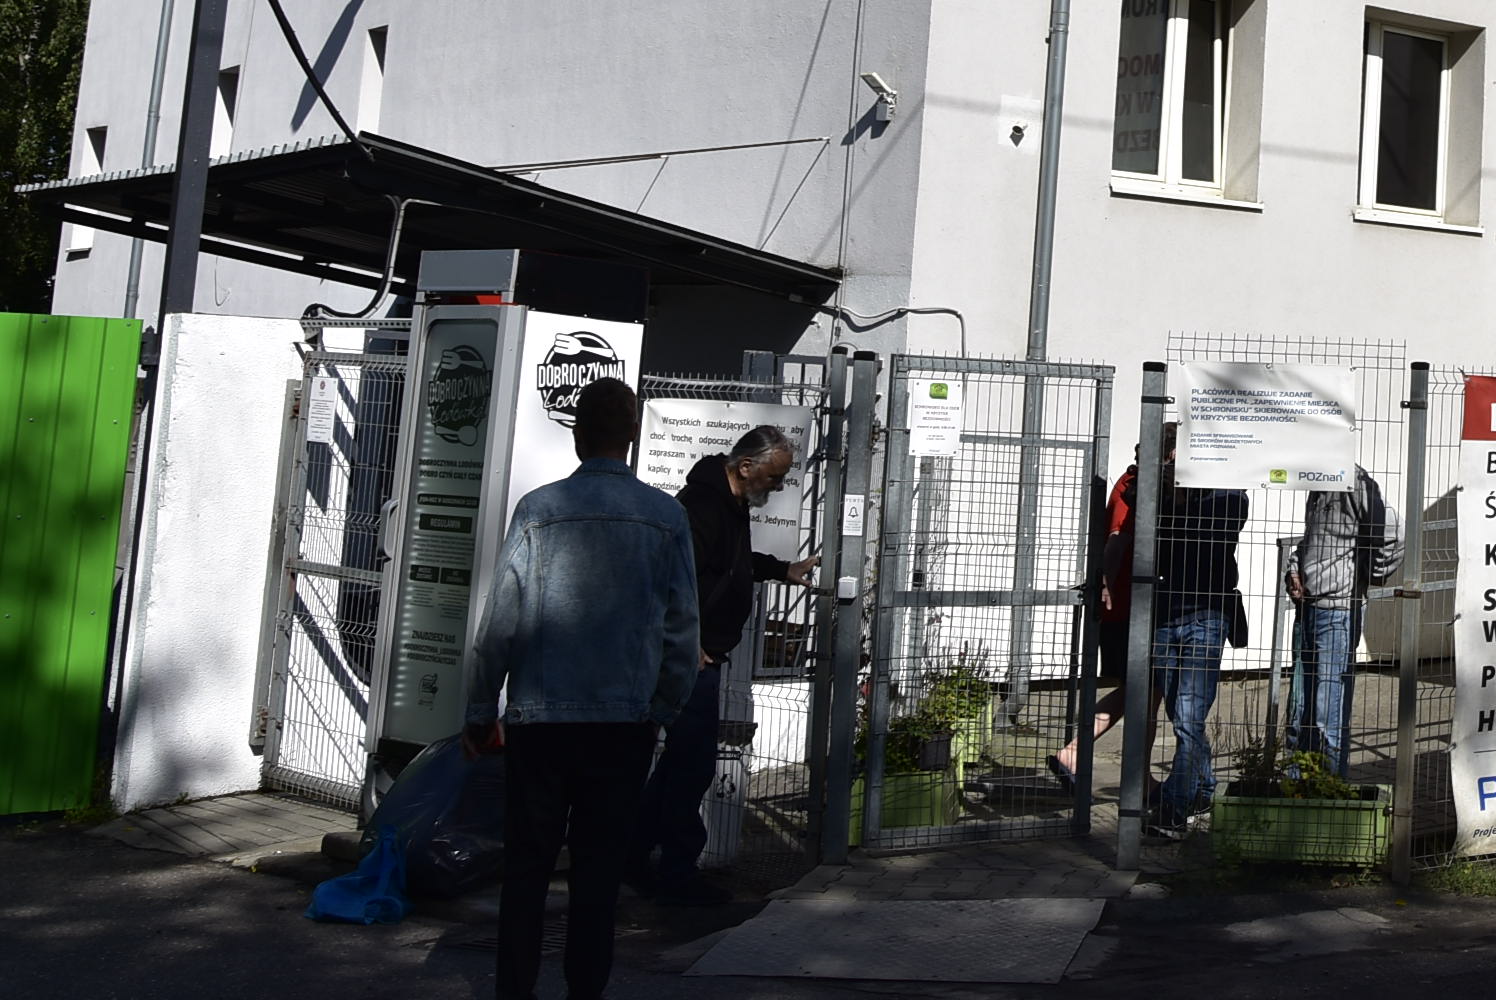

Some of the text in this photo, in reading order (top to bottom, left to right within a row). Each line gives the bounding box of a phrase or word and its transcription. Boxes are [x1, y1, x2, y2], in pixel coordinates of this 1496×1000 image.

[538, 361, 623, 388] DOBROCZYNNA
[1191, 387, 1236, 396] PLACÓWKA
[1236, 389, 1278, 397] REALIZUJE
[1191, 397, 1235, 405] PUBLICZNE
[1307, 400, 1340, 408] MIEJSCA
[1253, 407, 1306, 415] SKIEROWANE
[1320, 408, 1342, 416] OSÓB
[1200, 414, 1239, 422] KRYZYSIE
[661, 416, 701, 427] Wszystkich
[706, 421, 750, 432] szukających
[790, 426, 805, 436] aby
[649, 432, 733, 448] choć trochę odpocząć
[648, 449, 686, 460] zapraszam
[647, 463, 671, 476] kaplicy
[764, 515, 797, 528] Jedynym
